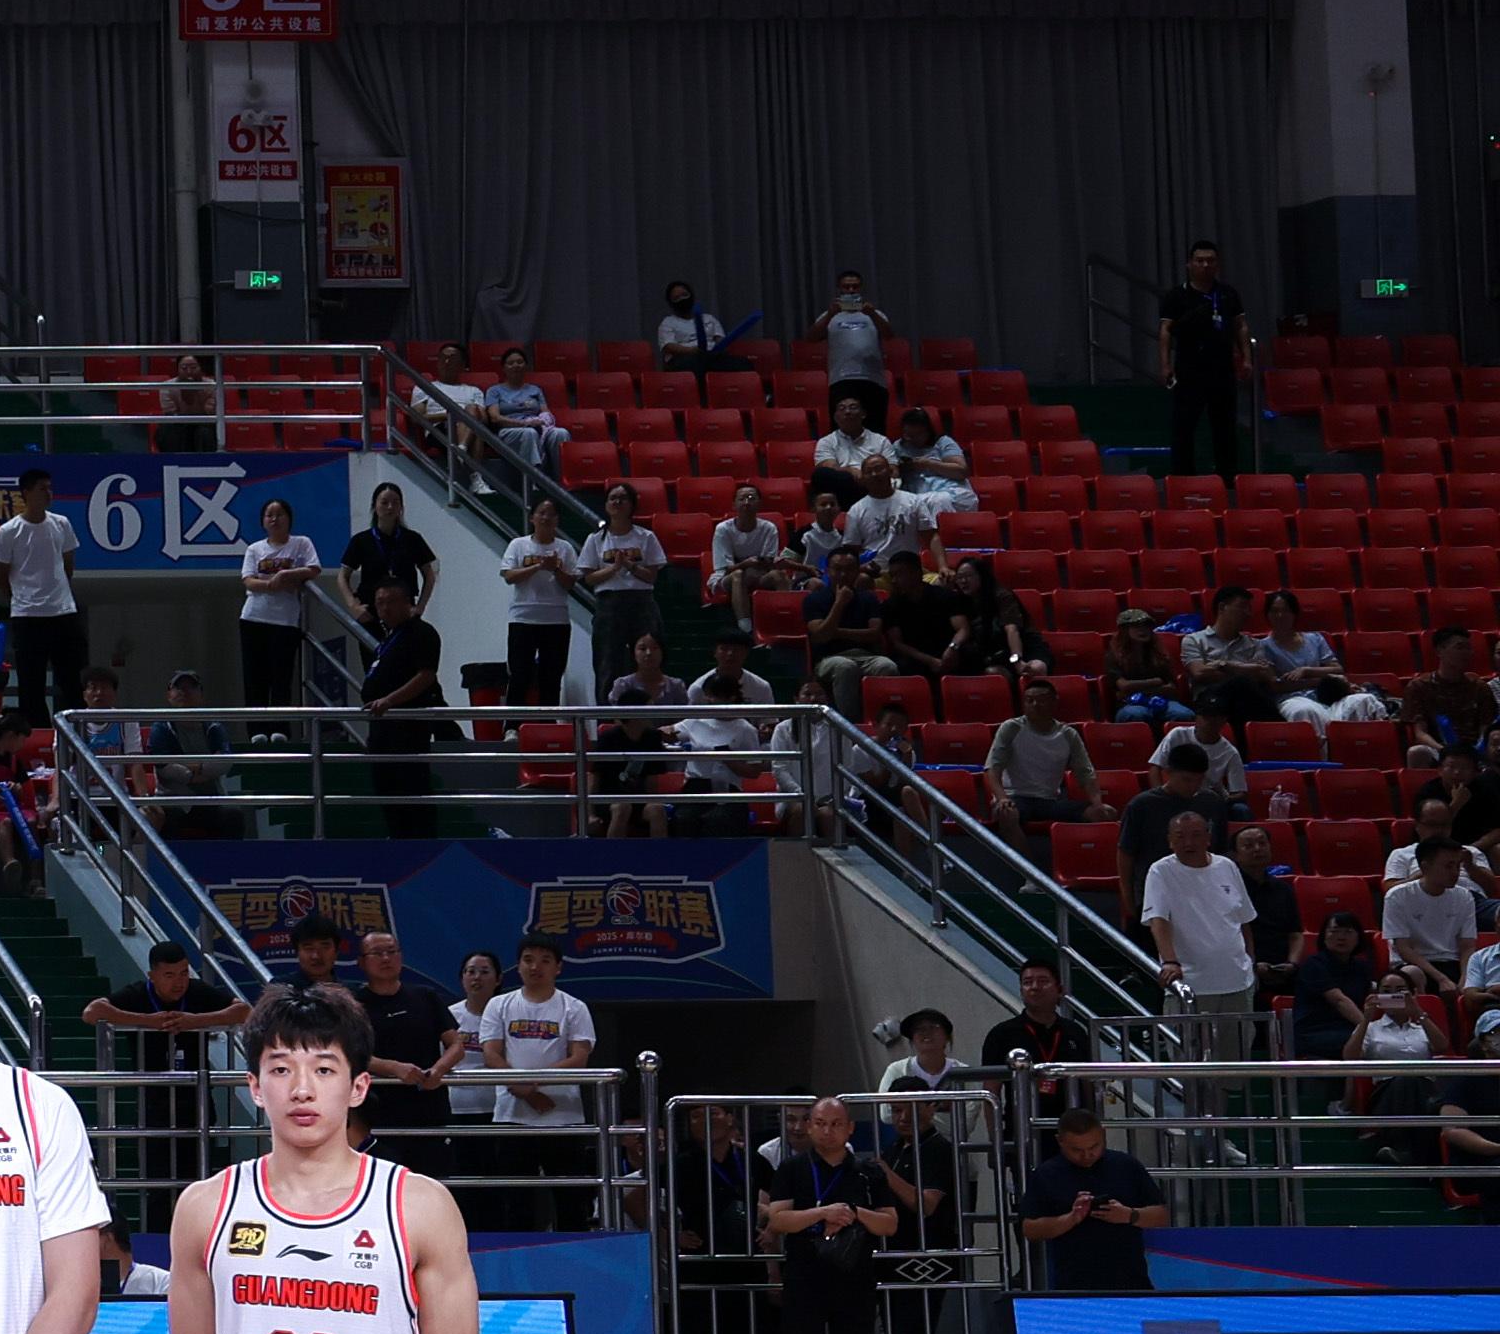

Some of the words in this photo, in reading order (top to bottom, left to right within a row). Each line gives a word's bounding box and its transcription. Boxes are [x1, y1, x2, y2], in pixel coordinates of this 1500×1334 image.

[195, 16, 322, 33] 请爱护公共设施
[353, 1260, 373, 1270] CGB
[234, 1274, 379, 1315] GUANGDONG
